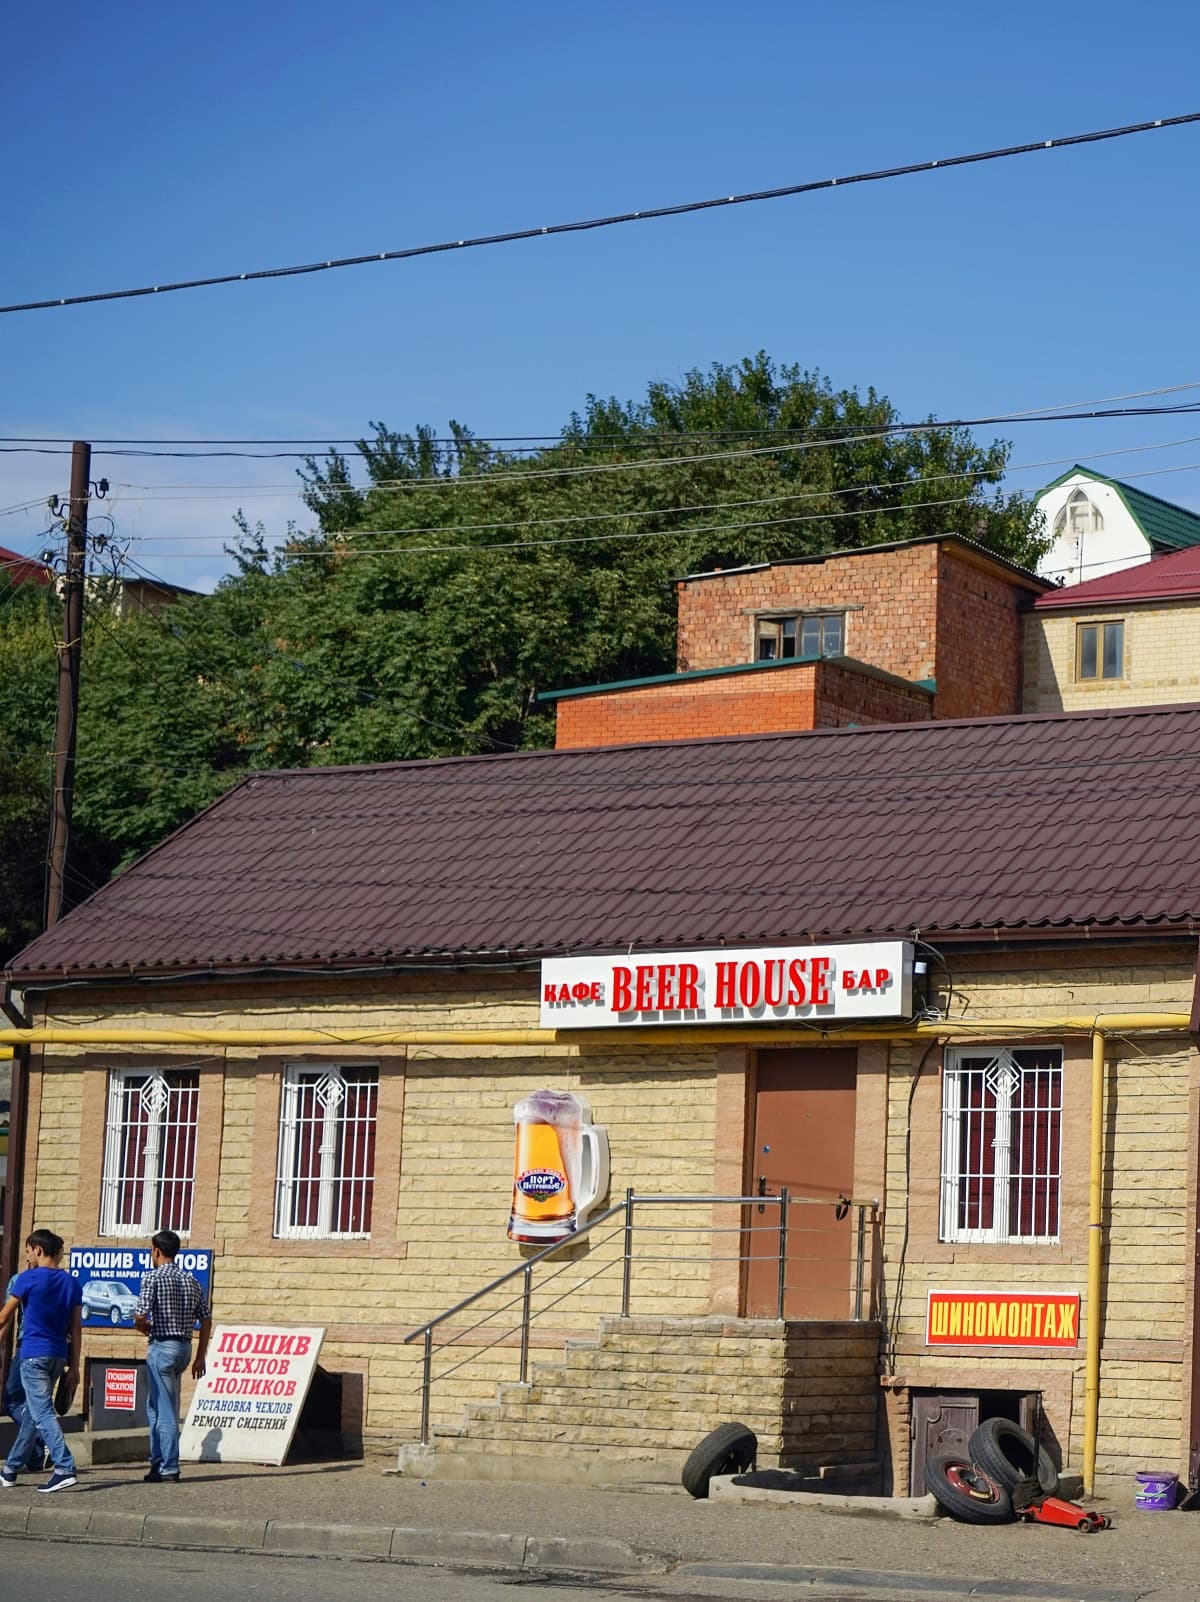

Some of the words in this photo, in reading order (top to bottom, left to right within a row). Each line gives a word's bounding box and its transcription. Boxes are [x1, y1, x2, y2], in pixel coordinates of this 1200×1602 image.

[610, 963, 700, 1012] BEER
[714, 957, 831, 1008] HOUSE
[842, 968, 889, 989] БАР
[544, 982, 601, 1003] КАФЕ
[70, 1252, 134, 1268] ПОШИВ
[138, 1253, 208, 1270] ЧЛОВ
[90, 1270, 100, 1278] НА
[101, 1270, 115, 1278] ВСЕ
[116, 1270, 139, 1279] МАРКИ
[931, 1301, 1077, 1339] ШИНОМОНТАЖ
[217, 1332, 312, 1356] ПОШИВ
[222, 1357, 291, 1375] ЧЕХЛОВ
[212, 1377, 297, 1396] ПОЛИКОВ
[196, 1400, 252, 1413] УСТАНОВКА
[255, 1402, 293, 1414] ЧЕХЛОВ
[192, 1415, 235, 1428] РЕМОНТ
[236, 1416, 288, 1431] СИДЕНИЙ
